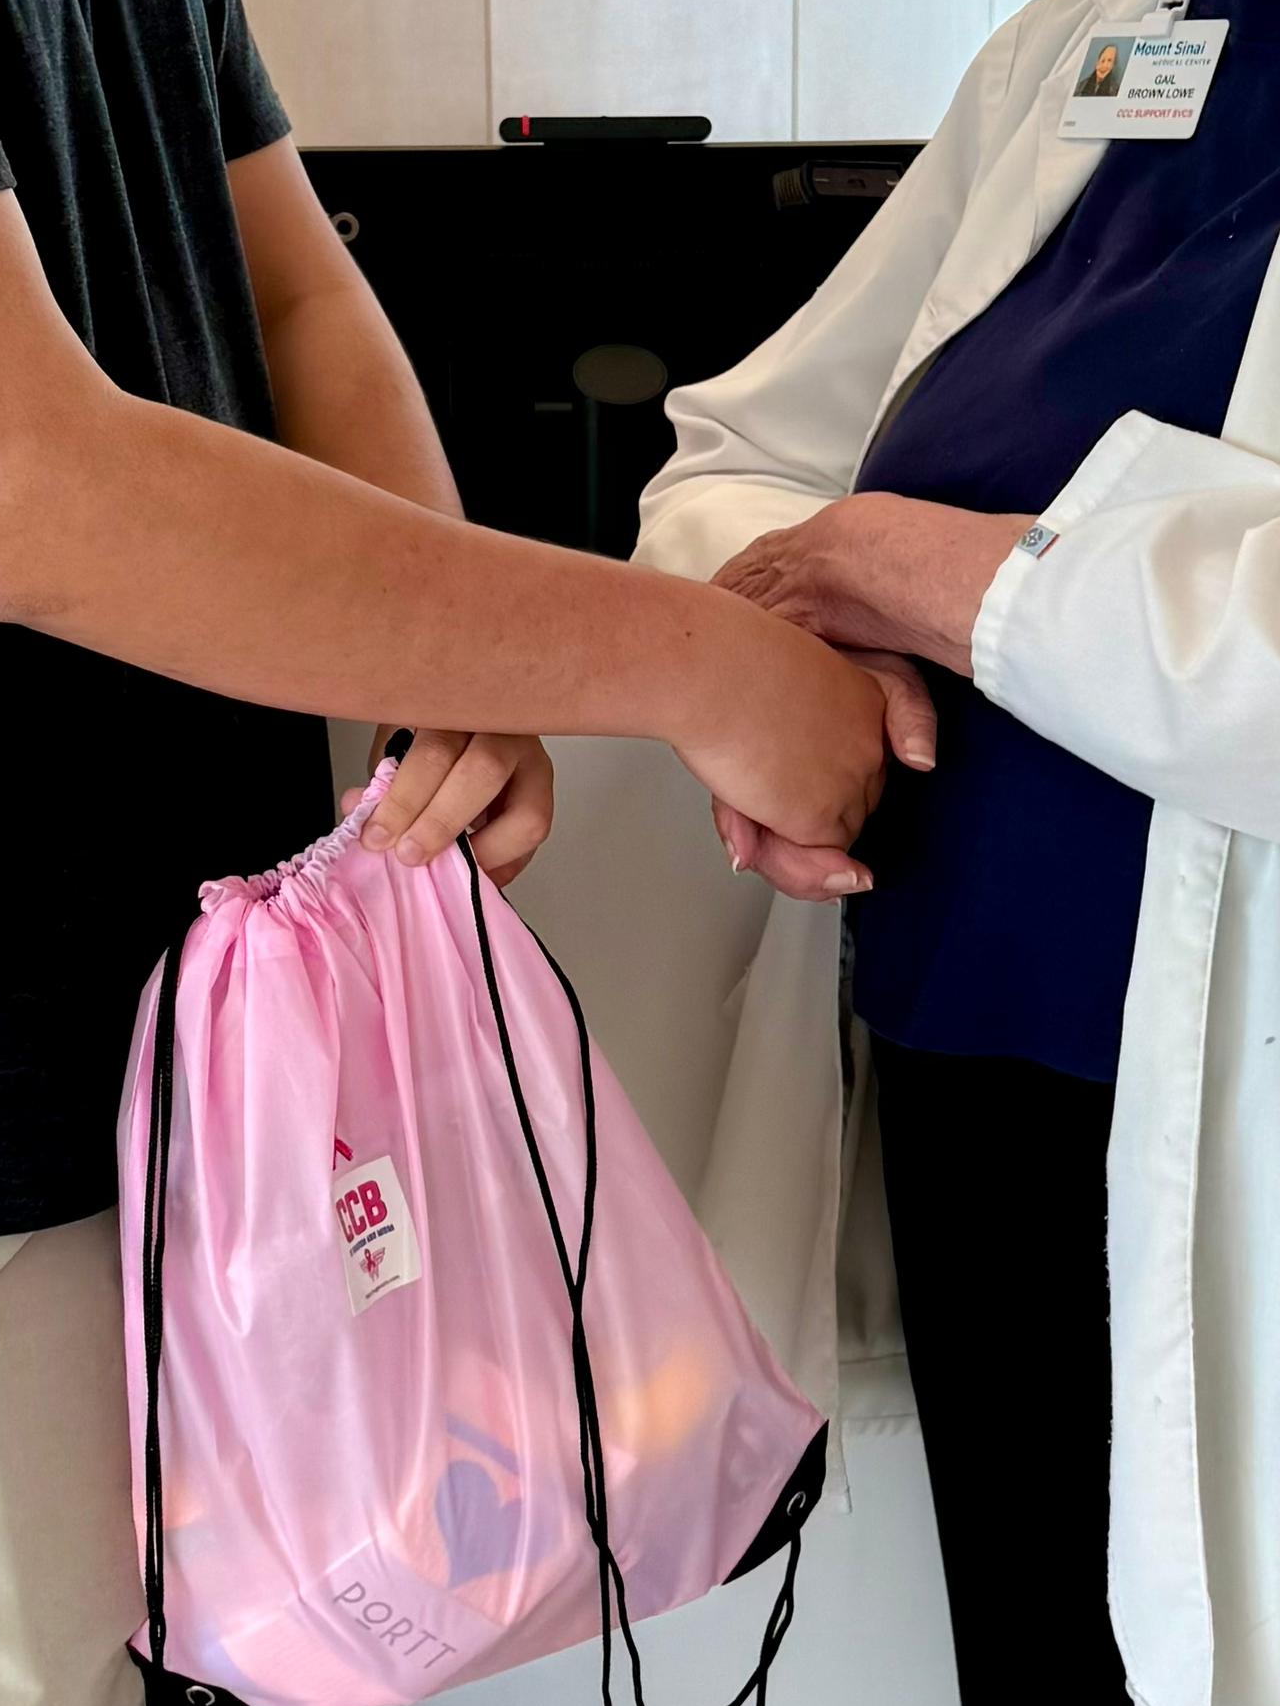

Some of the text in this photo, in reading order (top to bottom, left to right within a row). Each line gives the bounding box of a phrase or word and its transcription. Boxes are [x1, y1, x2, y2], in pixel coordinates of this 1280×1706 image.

[1134, 40, 1207, 57] Mount Sinai
[1154, 74, 1176, 85] GAIL
[1128, 88, 1195, 99] BROWN LOWE
[335, 1180, 388, 1243] CCB
[332, 1581, 457, 1670] PORTT
